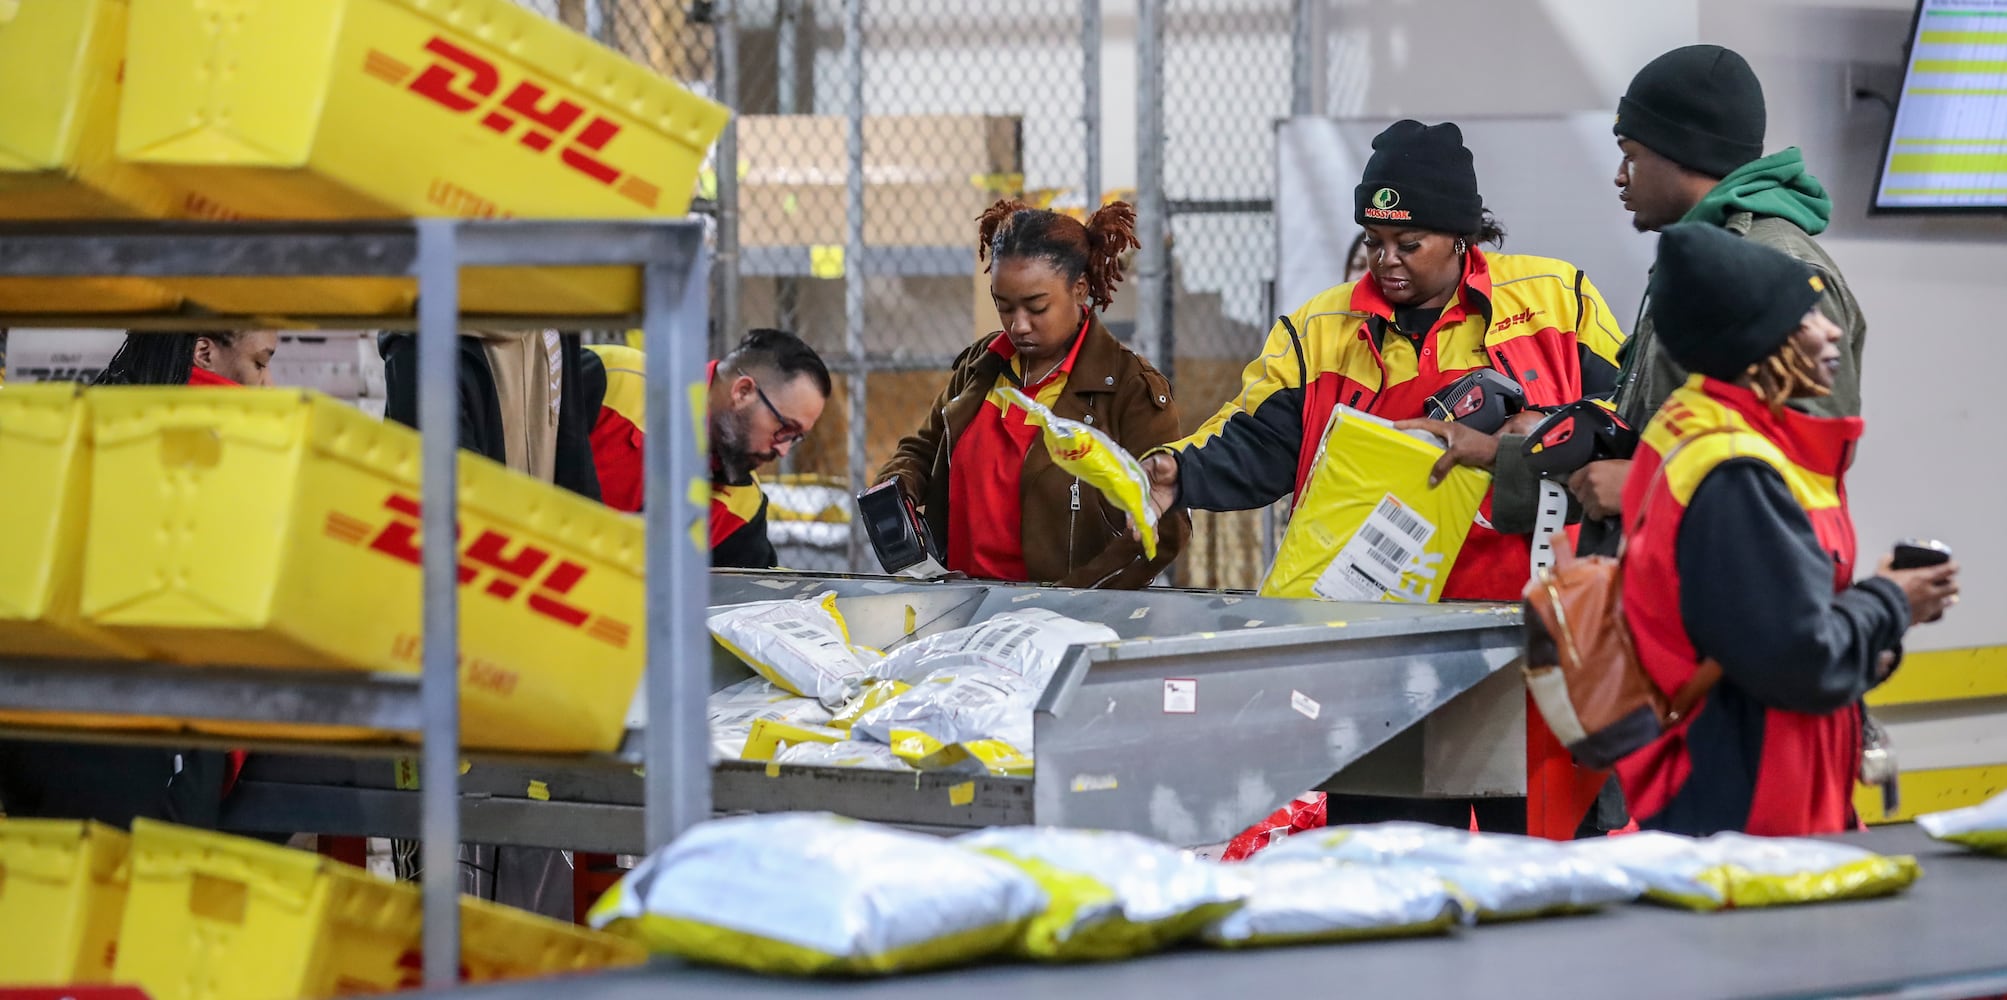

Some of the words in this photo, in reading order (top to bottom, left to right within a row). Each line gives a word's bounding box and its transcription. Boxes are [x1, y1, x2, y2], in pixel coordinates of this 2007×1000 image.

[407, 36, 622, 186] DHL
[1365, 207, 1391, 219] MOSSY
[1495, 307, 1535, 331] DHL
[369, 494, 589, 627] DHL
